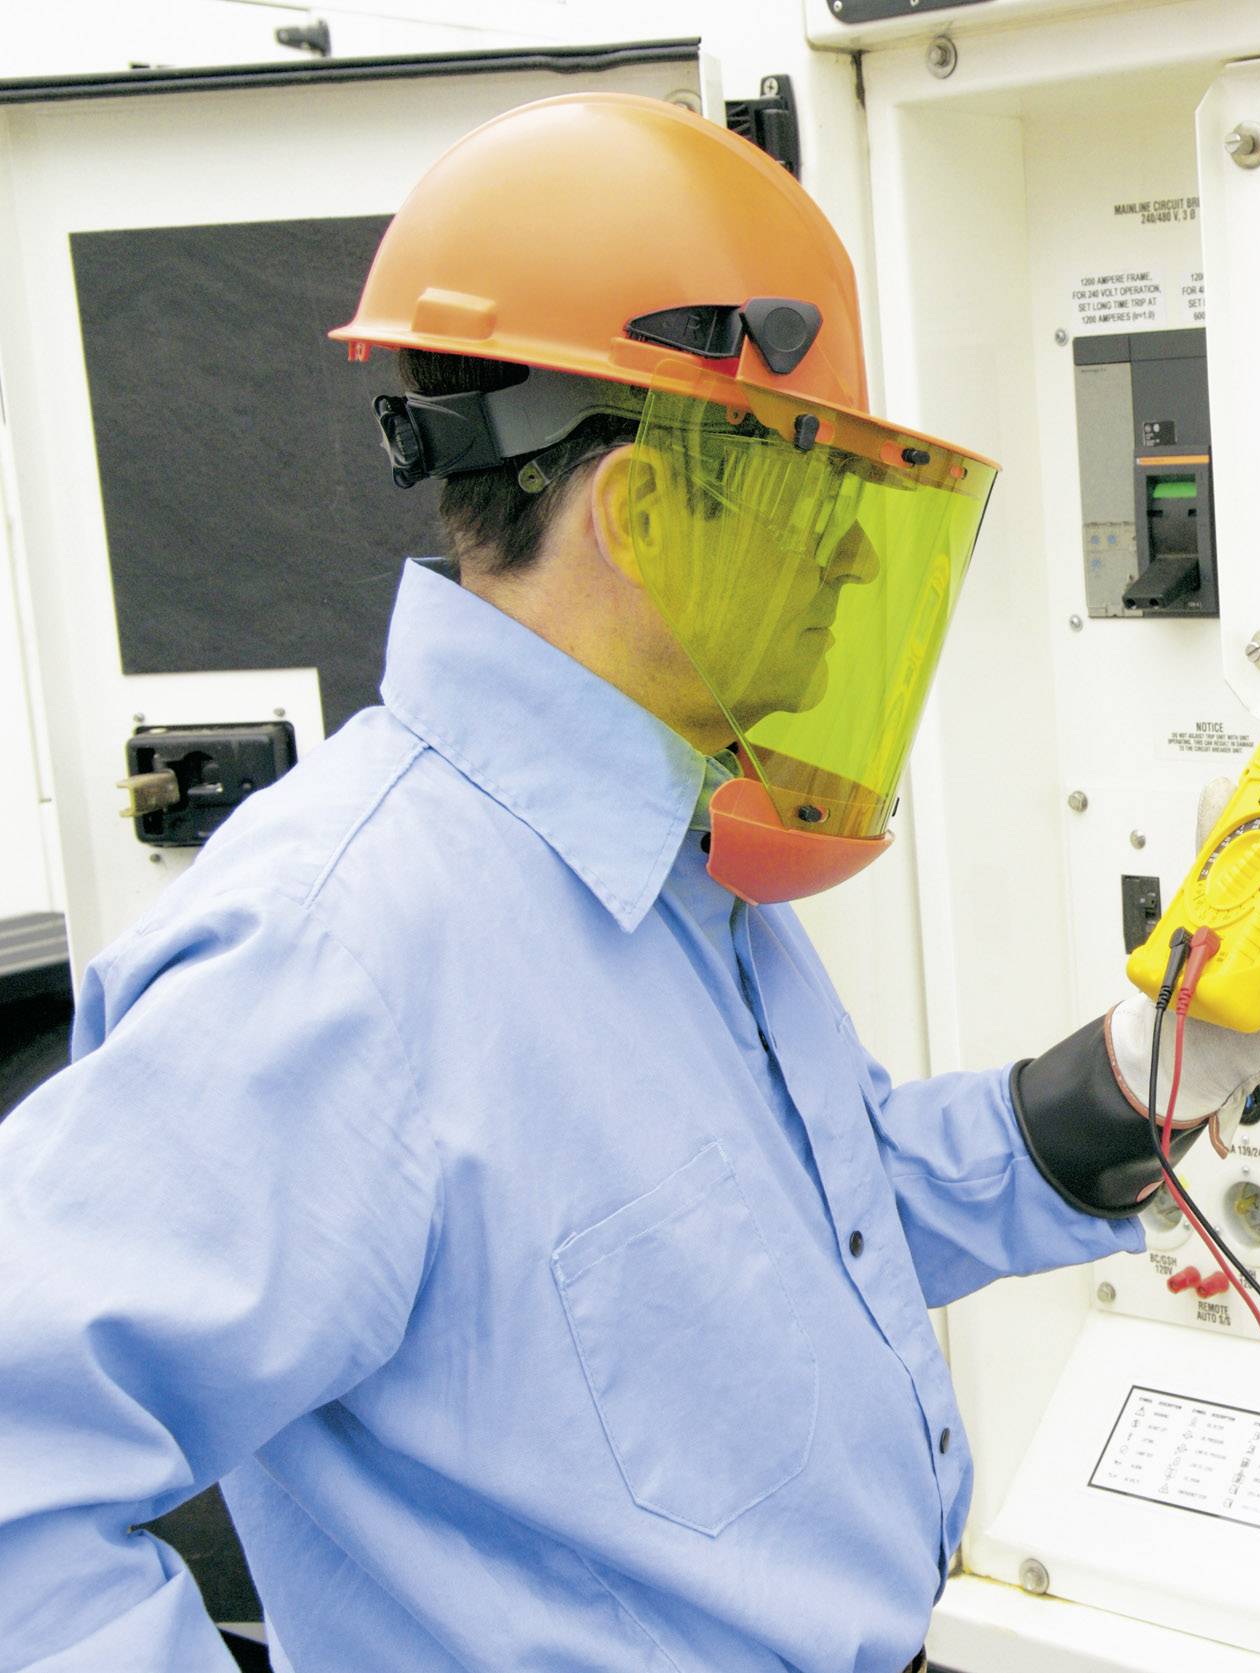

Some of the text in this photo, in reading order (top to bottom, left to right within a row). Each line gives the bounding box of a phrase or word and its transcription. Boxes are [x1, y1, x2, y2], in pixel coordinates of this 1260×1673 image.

[1114, 201, 1151, 216] MAINLINE
[1153, 198, 1183, 212] CIRCUIT
[1141, 211, 1171, 225] 240/480
[1080, 277, 1095, 287] 1200
[1097, 274, 1125, 285] AMPERE
[1072, 290, 1087, 300] FOR
[1101, 287, 1118, 298] VOLT
[1182, 286, 1197, 296] FOR
[1078, 303, 1091, 312] SET
[1093, 301, 1112, 311] LONG
[1113, 299, 1129, 310] TIME
[1148, 297, 1157, 306] AT
[1082, 312, 1131, 325] 1200 AMPERES
[1196, 722, 1223, 733] NOTICE
[1198, 1301, 1228, 1314] REMOTE
[1197, 1310, 1216, 1323] AUTO
